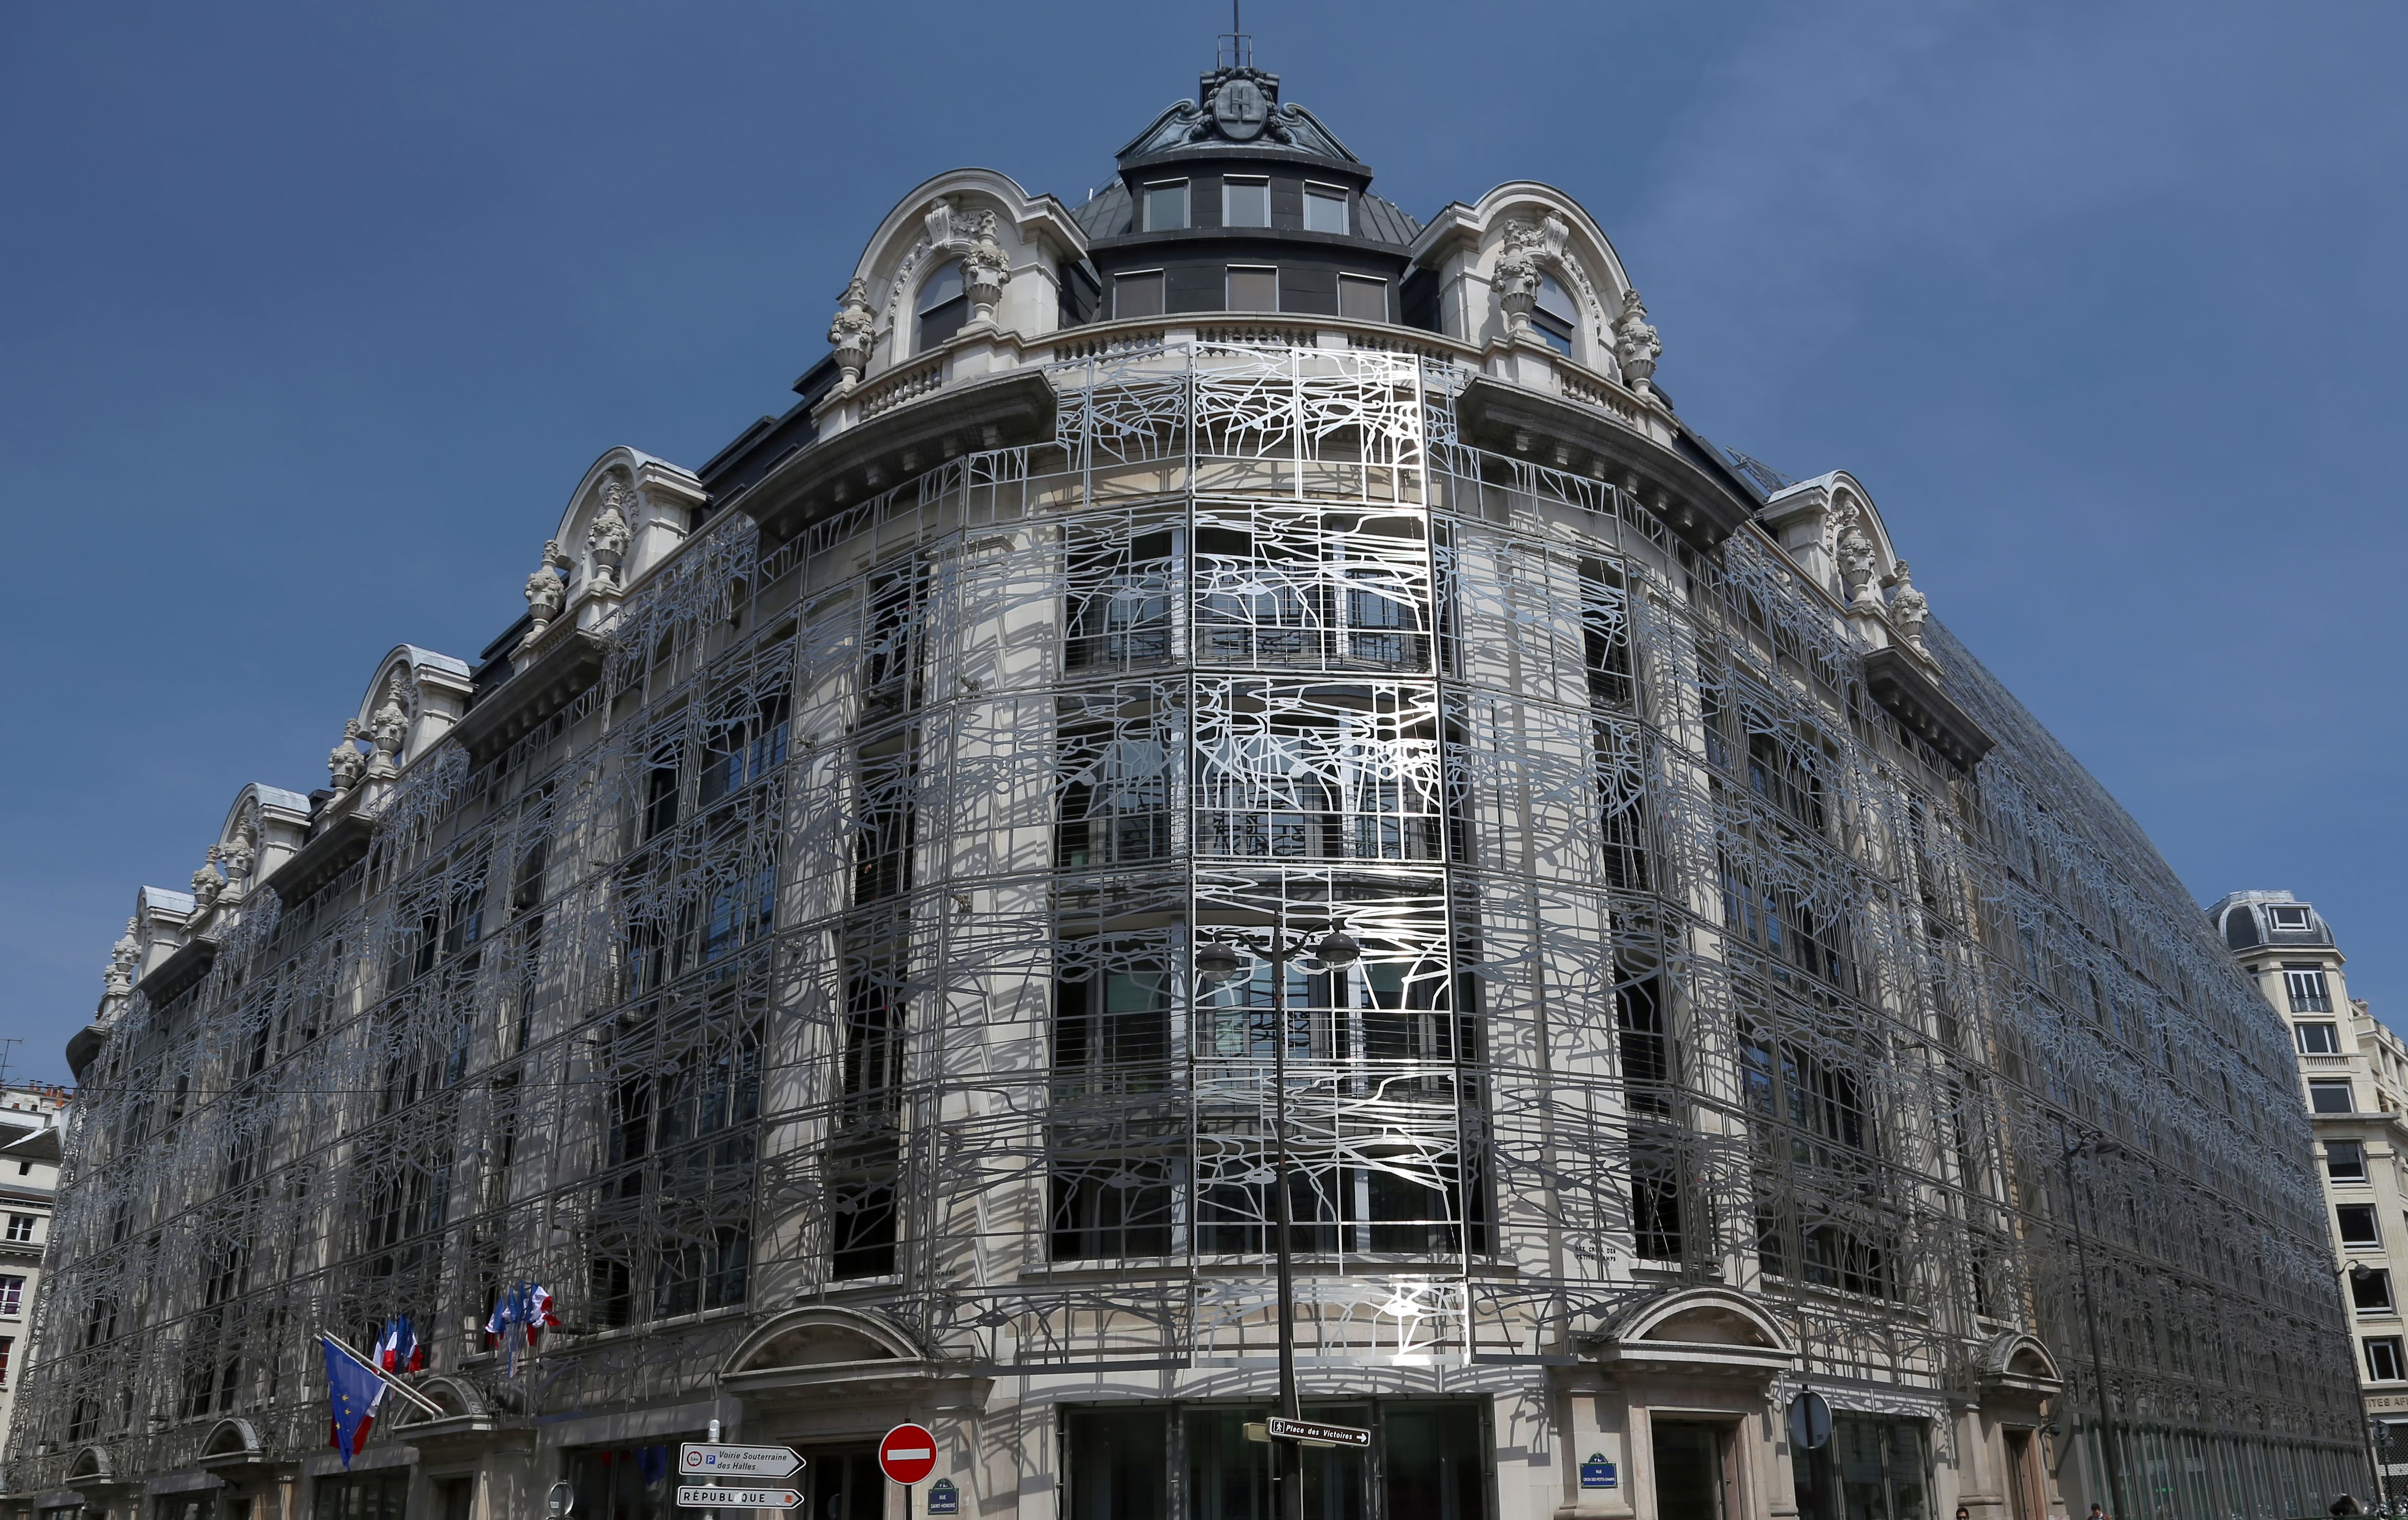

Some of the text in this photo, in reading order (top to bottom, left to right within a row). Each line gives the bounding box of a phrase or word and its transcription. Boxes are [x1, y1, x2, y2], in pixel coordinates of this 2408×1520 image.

[1286, 1424, 1304, 1433] Place
[1323, 1430, 1352, 1439] Victoires
[719, 1451, 787, 1460] Voirie Souterraine
[684, 1490, 765, 1503] RÉPUBLQUE
